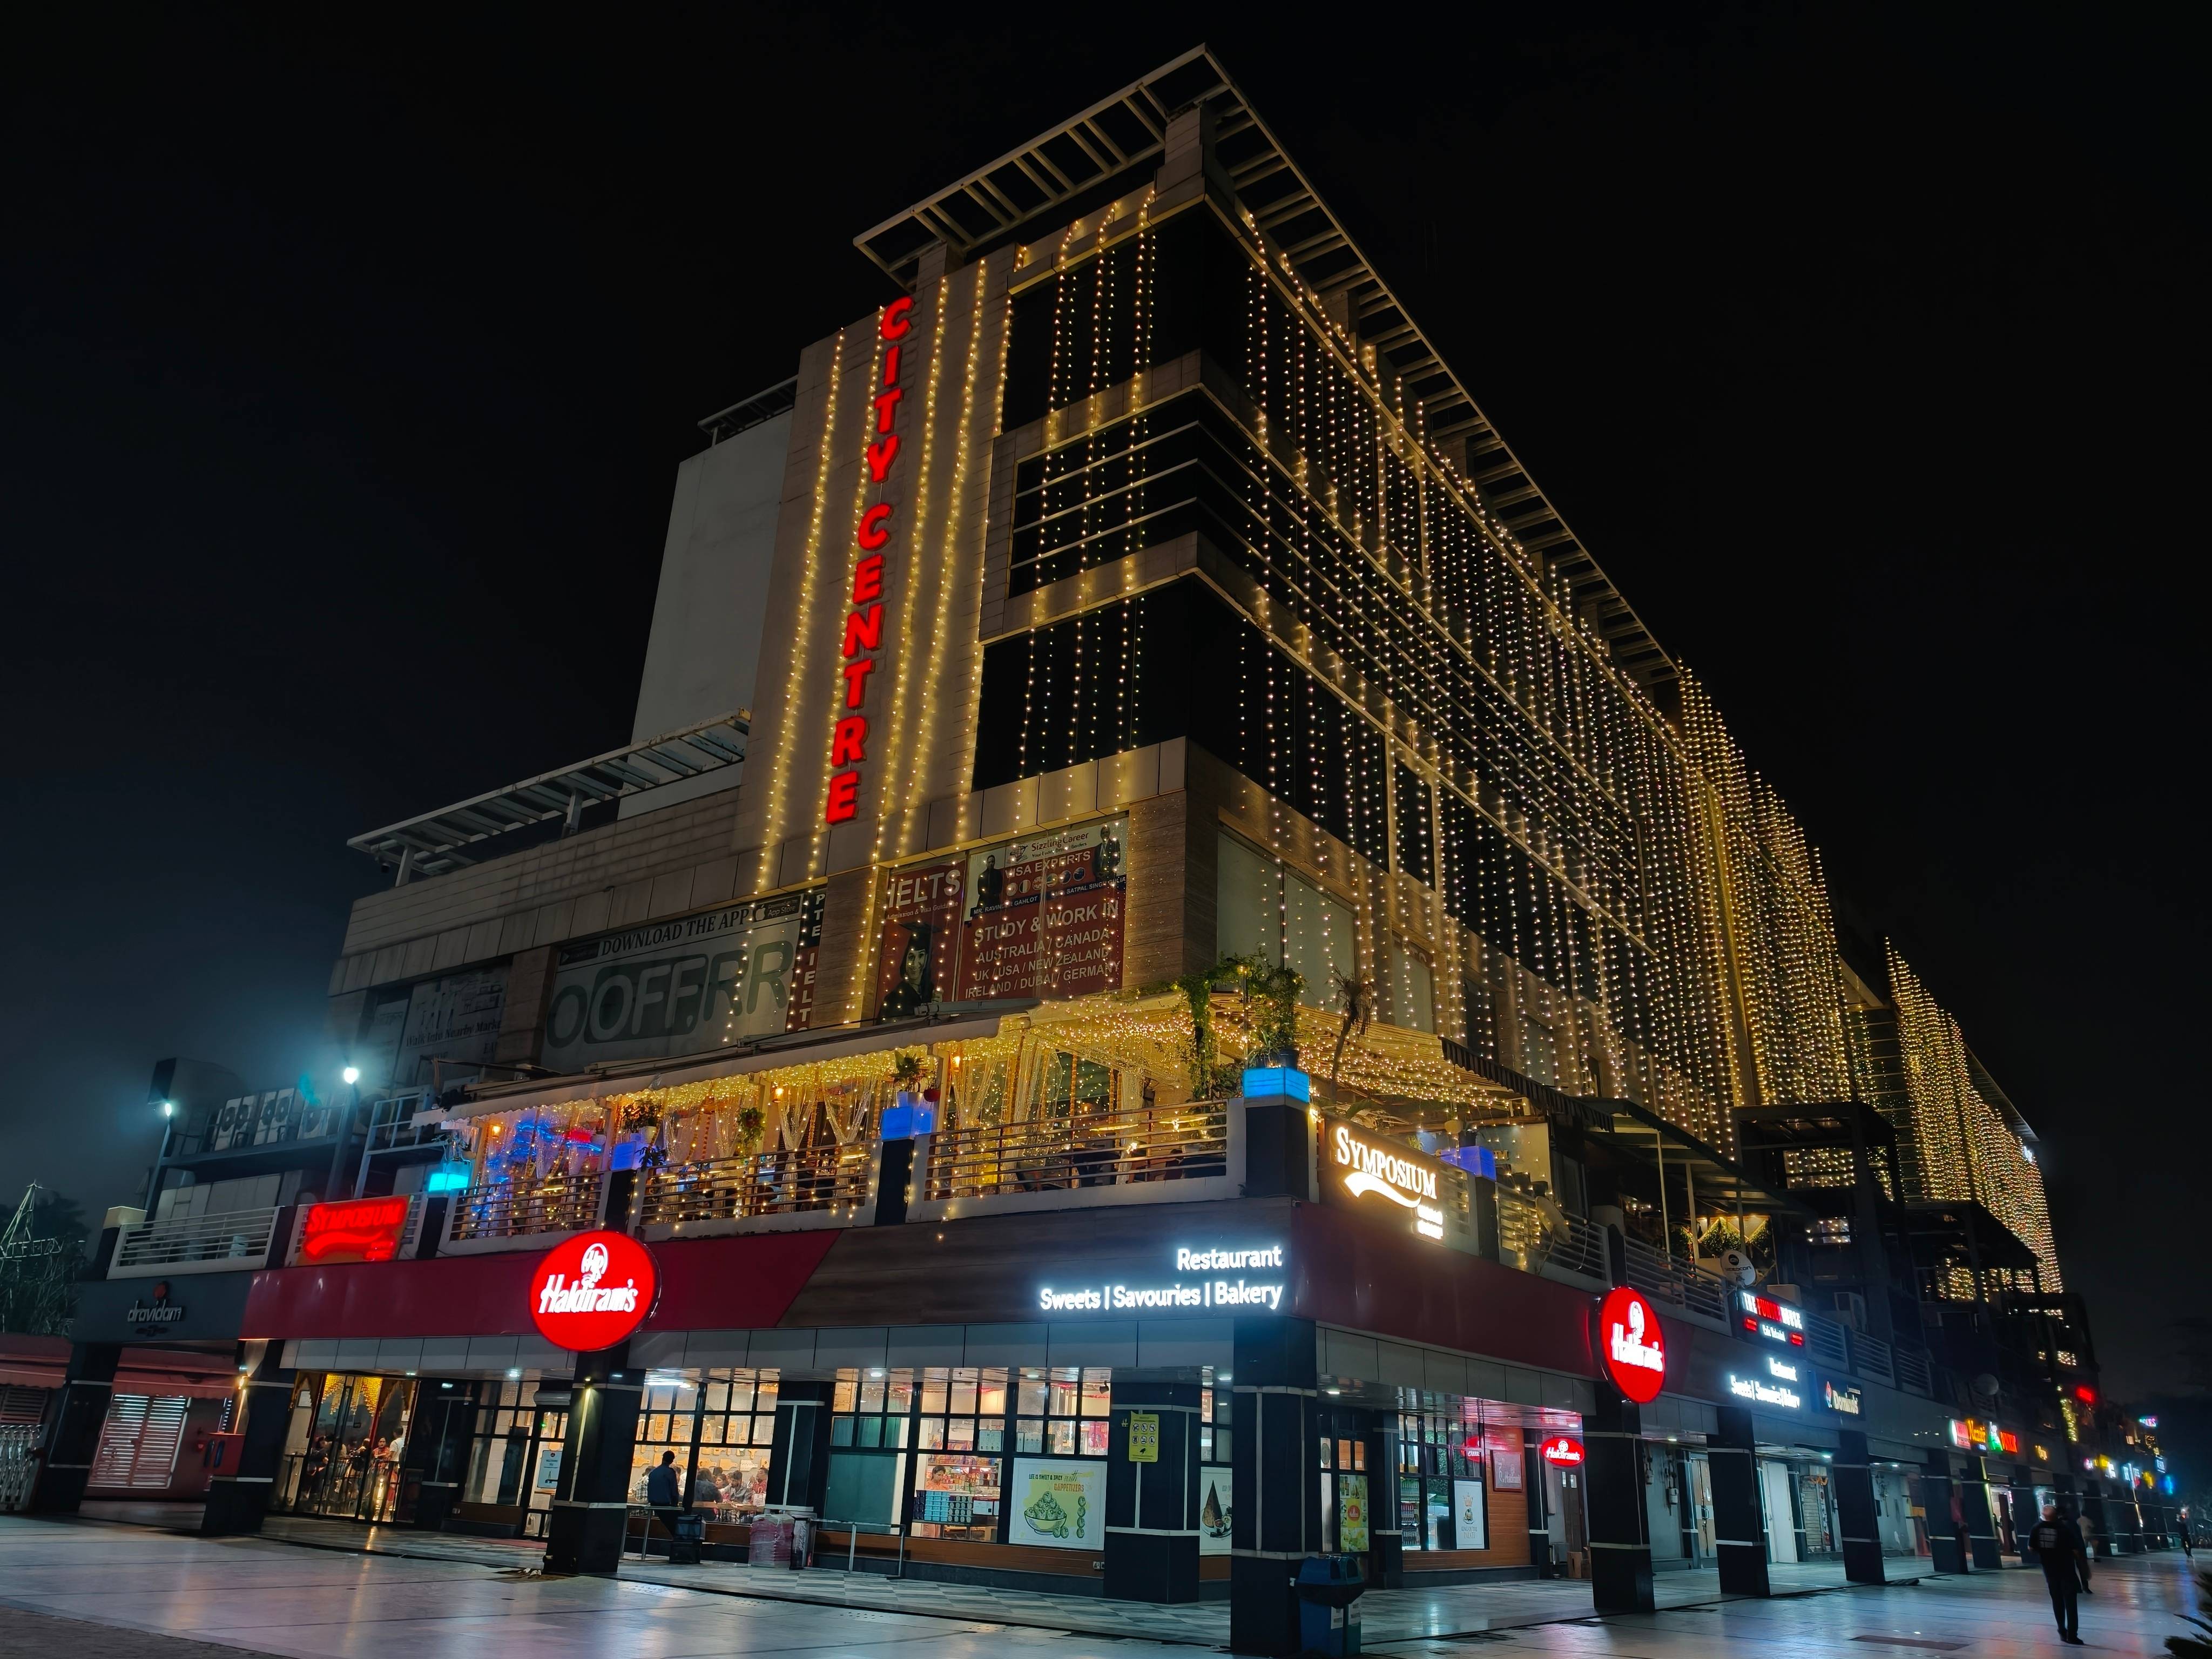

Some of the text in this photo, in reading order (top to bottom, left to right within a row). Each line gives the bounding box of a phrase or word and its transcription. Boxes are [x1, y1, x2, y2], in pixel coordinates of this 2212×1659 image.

[867, 296, 915, 483] CITY
[826, 503, 893, 824] CENTRE
[1031, 832, 1089, 852] Sizzling Career
[1035, 851, 1091, 873] EXPERTS
[888, 869, 961, 908] IELTS
[933, 901, 959, 911] Guide
[1014, 895, 1038, 907] GAHLOT
[1067, 885, 1088, 894] SATPAL
[602, 924, 683, 956] DOWNLOAD
[687, 916, 716, 936] THE
[718, 909, 750, 930] APP
[812, 893, 826, 937] PTE
[974, 900, 1119, 944] STUDY & WORK IN
[978, 940, 1046, 963] AUSTRALIA
[1055, 928, 1110, 948] CANADA
[966, 981, 1011, 999] IRELAND
[1020, 973, 1054, 989] DUBAI
[1063, 961, 1121, 981] GERMANY
[975, 969, 990, 981] UK
[999, 965, 1020, 978] USA
[1028, 956, 1054, 972] NEW
[1055, 947, 1109, 967] ZEALAND
[1337, 1127, 1437, 1199] SYMPOSIUM
[1177, 1246, 1283, 1270] Restaurant
[538, 1273, 639, 1313] Haldiram's
[1040, 1288, 1101, 1310] Sweets
[1113, 1284, 1201, 1308] Savouries
[1215, 1280, 1283, 1310] Bakery
